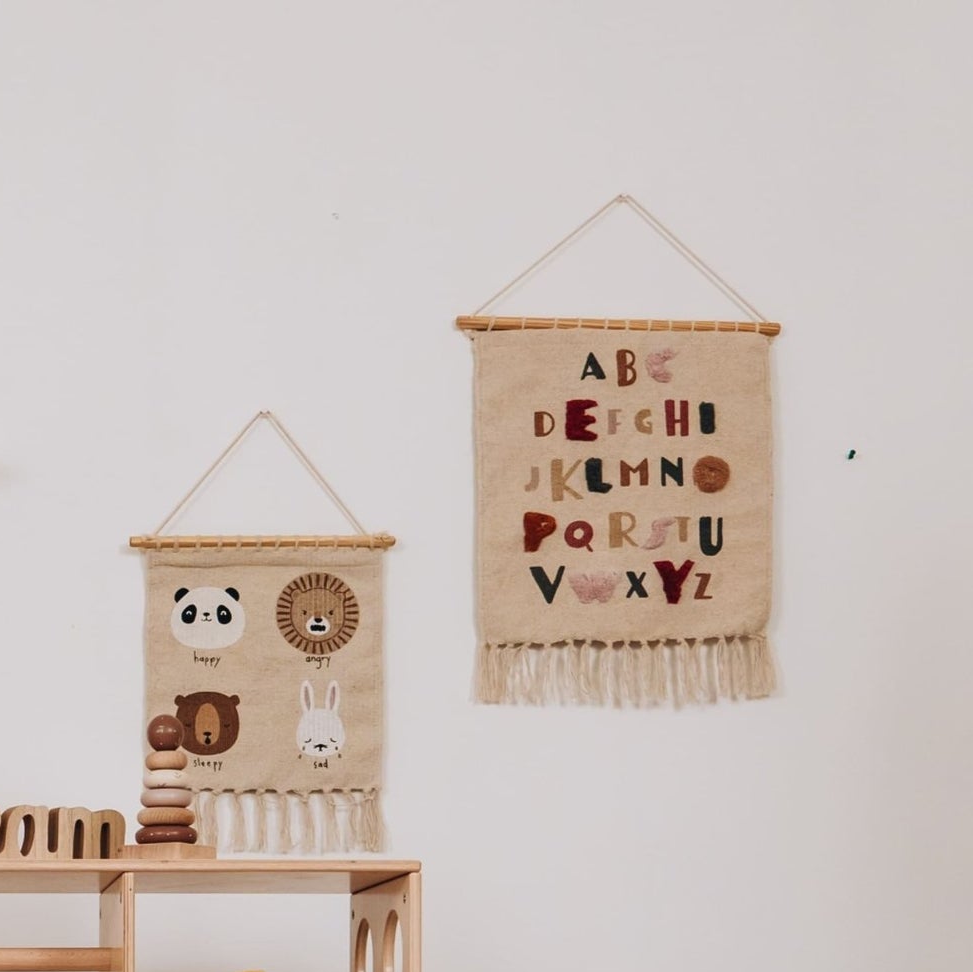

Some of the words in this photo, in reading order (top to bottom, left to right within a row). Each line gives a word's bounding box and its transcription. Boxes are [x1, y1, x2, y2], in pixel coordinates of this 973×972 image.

[194, 651, 221, 668] happy
[306, 656, 331, 669] angry
[193, 758, 223, 772] sleepy
[313, 759, 329, 769] sad
